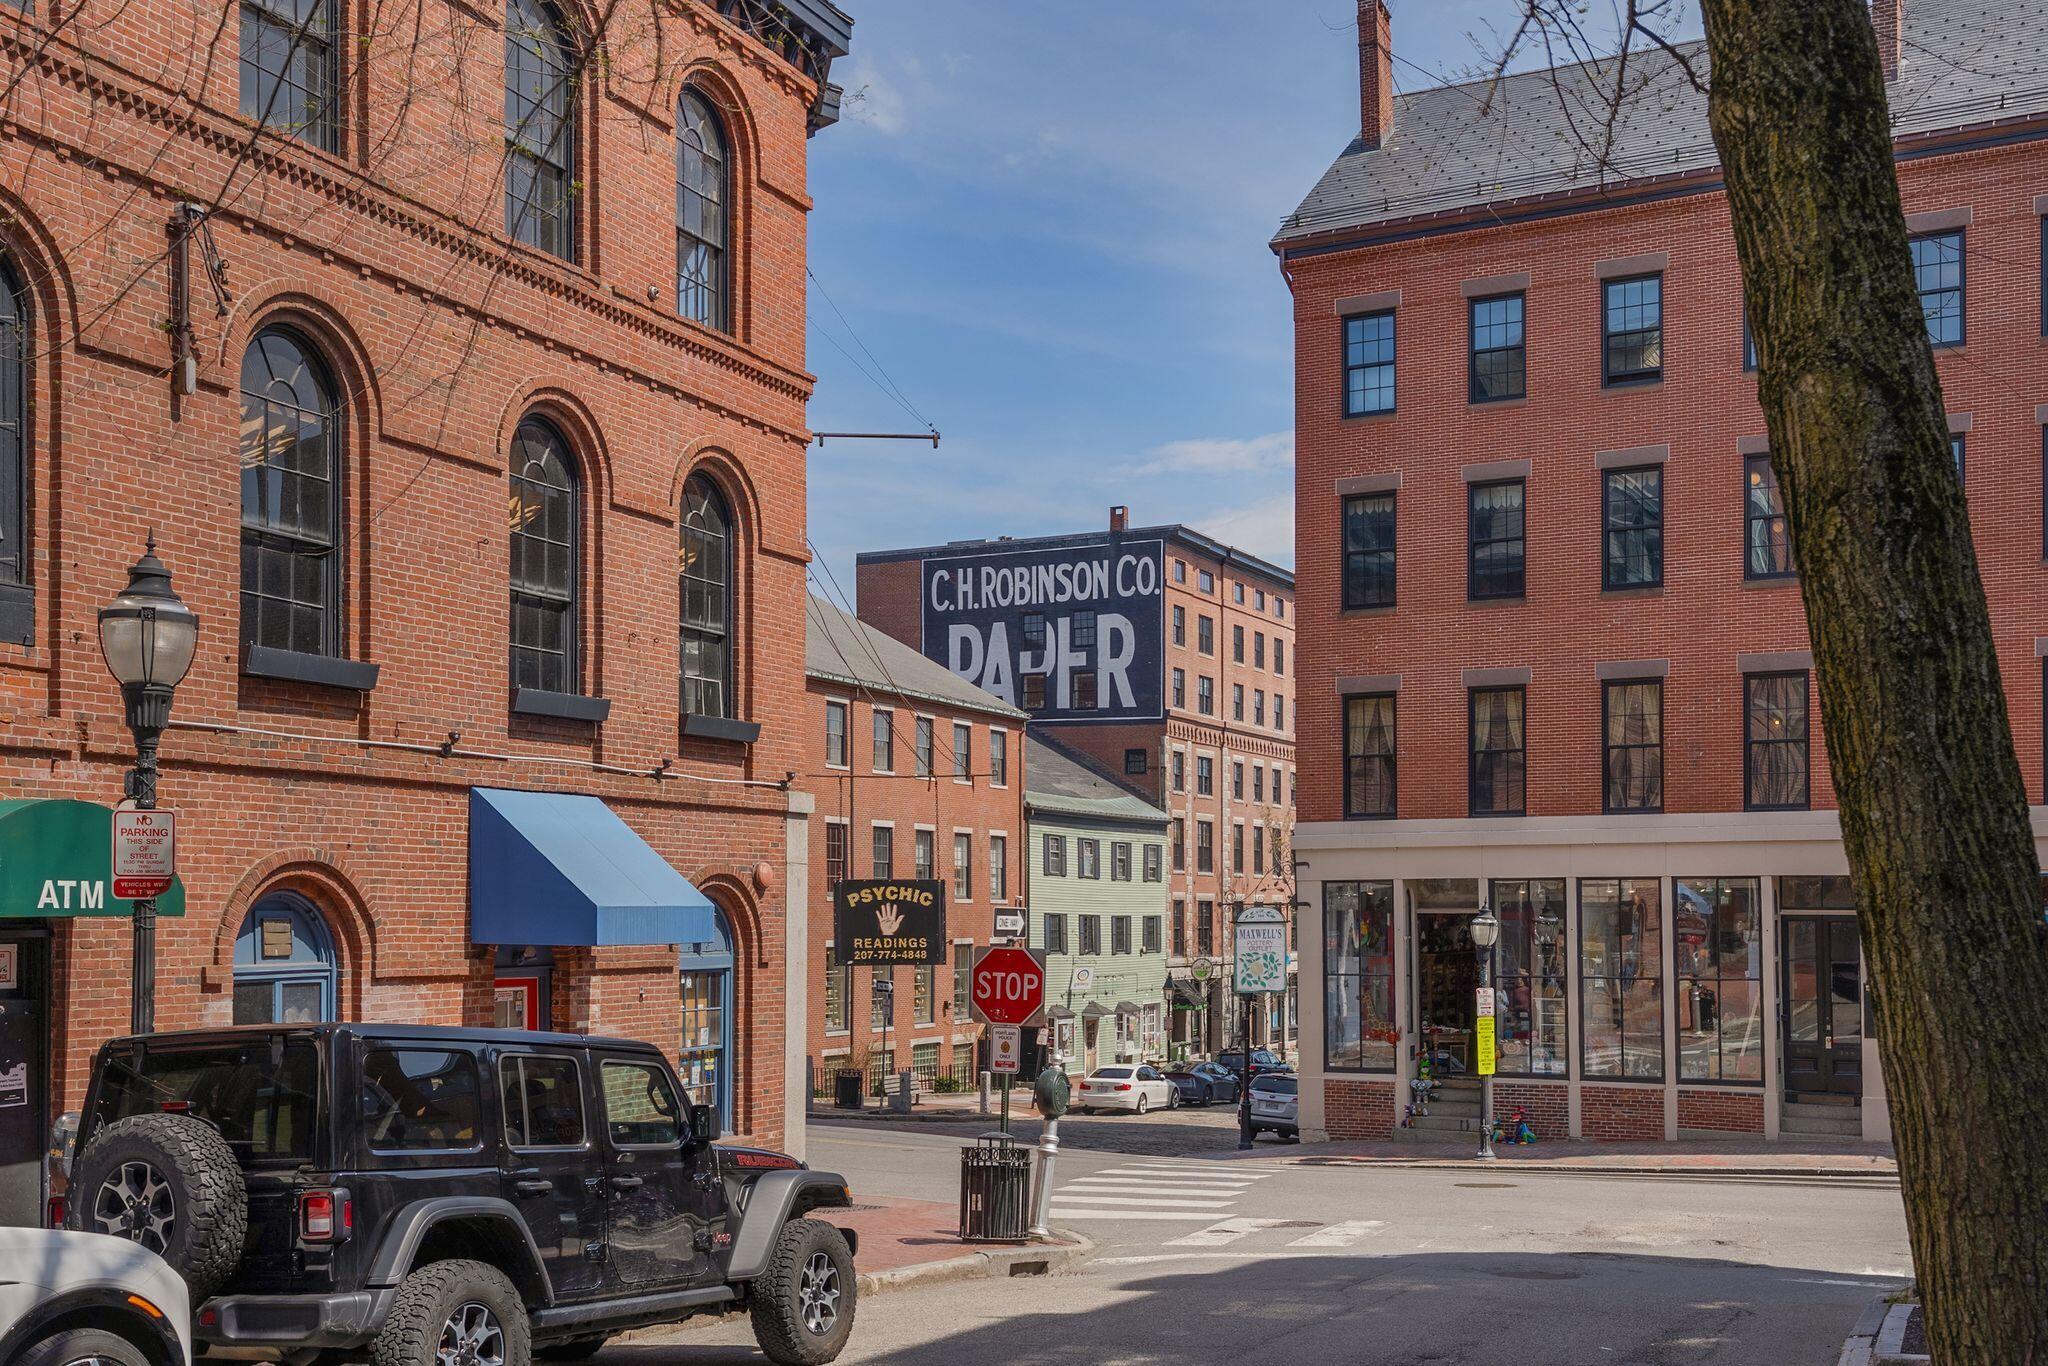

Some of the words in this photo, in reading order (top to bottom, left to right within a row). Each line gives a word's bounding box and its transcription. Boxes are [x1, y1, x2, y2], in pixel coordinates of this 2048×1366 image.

[1116, 554, 1161, 597] CO.
[136, 816, 152, 826] NO
[120, 828, 169, 837] PARKING
[37, 880, 104, 909] ATM
[847, 885, 934, 908] PSYCHIC
[1239, 928, 1282, 940] MAXWELL'S
[854, 937, 927, 949] READINGS
[854, 950, 928, 960] 207-774-4848
[976, 971, 1039, 1001] STOP
[736, 1154, 801, 1168] RUBICON
[714, 1232, 732, 1244] Jeep
